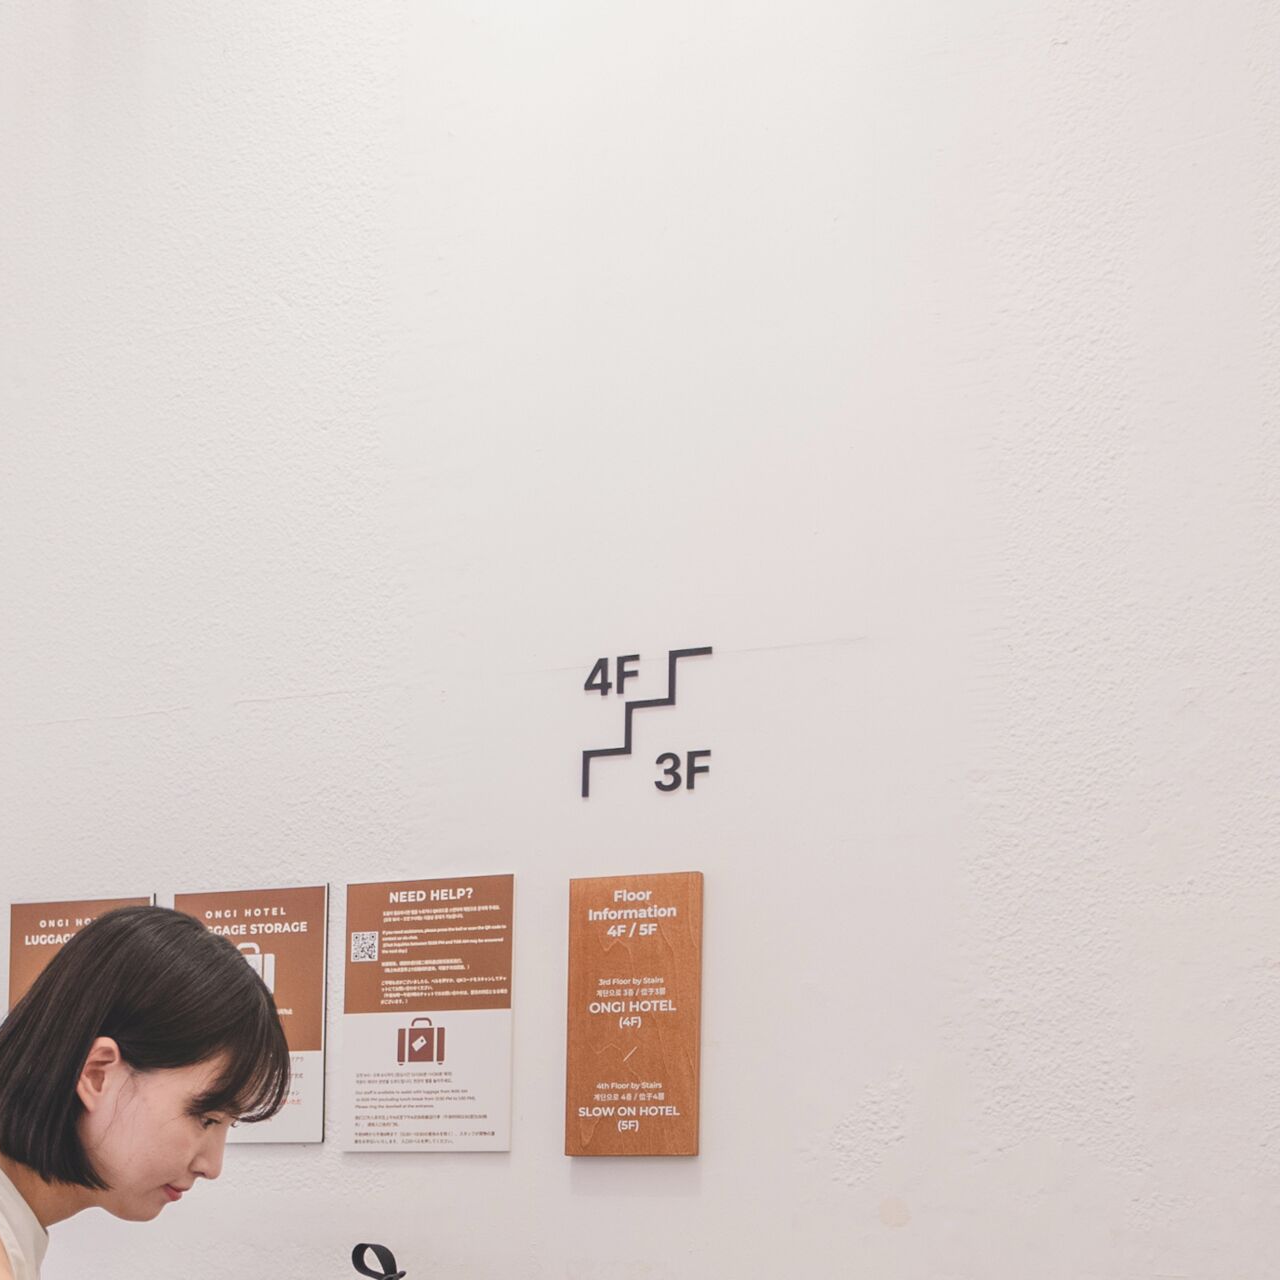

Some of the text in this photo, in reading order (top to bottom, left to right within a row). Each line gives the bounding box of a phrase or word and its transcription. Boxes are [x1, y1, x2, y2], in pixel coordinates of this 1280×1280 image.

[584, 654, 640, 696] 4F
[654, 749, 712, 792] 3F
[389, 887, 473, 903] NEED HELP?
[614, 889, 652, 902] Floor
[205, 907, 286, 919] ONGI HOTEL
[588, 904, 677, 921] Information
[39, 919, 69, 928] ONGI
[250, 921, 308, 934] STORAGE
[607, 925, 626, 937] 4F
[639, 923, 658, 935] 5F
[632, 978, 642, 986] by
[643, 976, 664, 984] Stairs
[589, 1000, 677, 1013] ONGI HOTEL
[619, 1016, 642, 1029] (4F)
[631, 1082, 641, 1090] by
[641, 1081, 662, 1089] Stairs
[578, 1105, 680, 1117] SLOW ON HOTEL
[617, 1120, 639, 1132] (5F)
